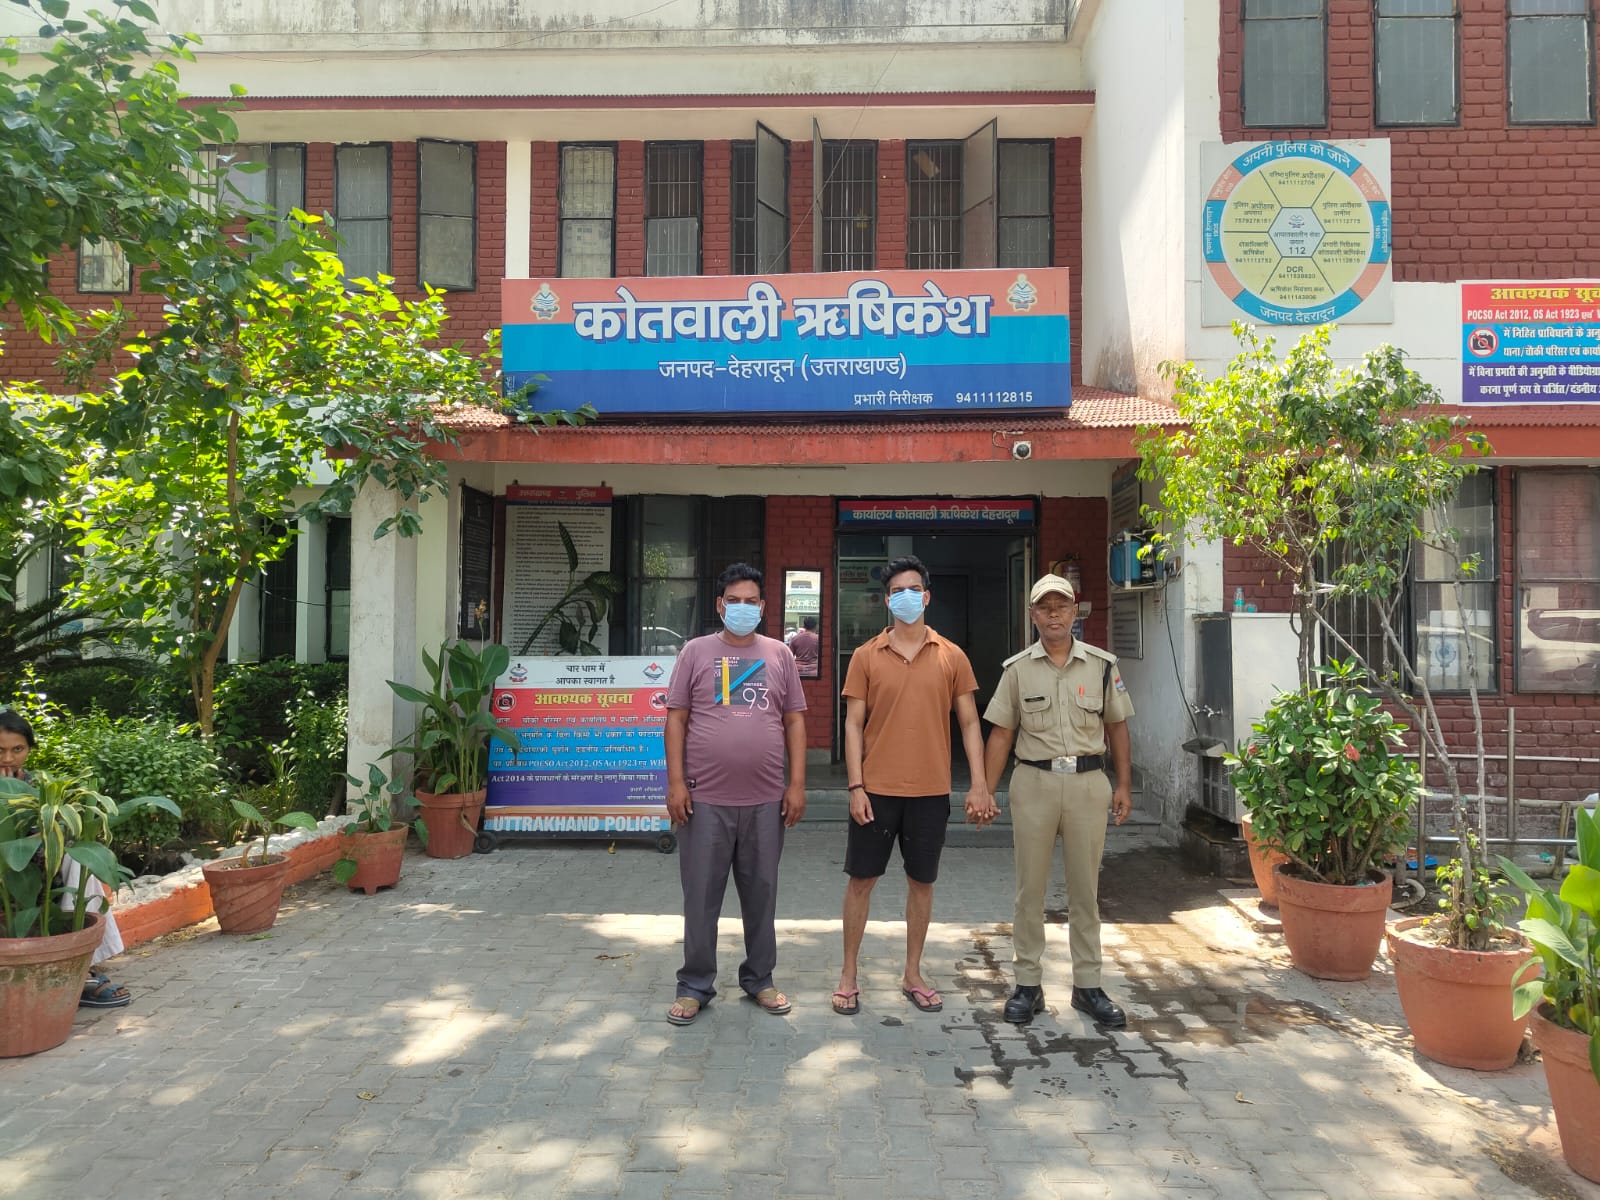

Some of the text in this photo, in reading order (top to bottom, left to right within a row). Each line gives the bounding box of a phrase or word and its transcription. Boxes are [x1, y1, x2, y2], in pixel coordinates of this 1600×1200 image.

[1242, 143, 1273, 167] अपनी
[1276, 141, 1307, 157] पुलिस
[1309, 142, 1324, 156] को
[1491, 287, 1571, 300] आवश्यक
[573, 279, 994, 343] कोतवाली ऋषिकेश
[1260, 305, 1336, 323] जनपद देहरादून
[1467, 309, 1493, 320] POCSO
[1495, 309, 1508, 320] Act
[1510, 309, 1531, 321] 2012,
[1545, 309, 1558, 320] Act
[1560, 308, 1580, 320] 1923
[801, 352, 907, 380] (उत्तराखण्ड)
[854, 390, 1034, 406] प्रभारी निरीक्षक 9411112815
[852, 505, 1020, 525] कार्यालय कोतवाली ऋषिकेश देहरादून
[566, 662, 606, 673] चार धाम में
[556, 674, 616, 685] आपका स्वागत है
[534, 693, 634, 708] आवश्यक सूचना
[743, 688, 770, 711] 93
[604, 759, 616, 767] Act
[494, 815, 661, 832] UTTRAKHAND POLICE
